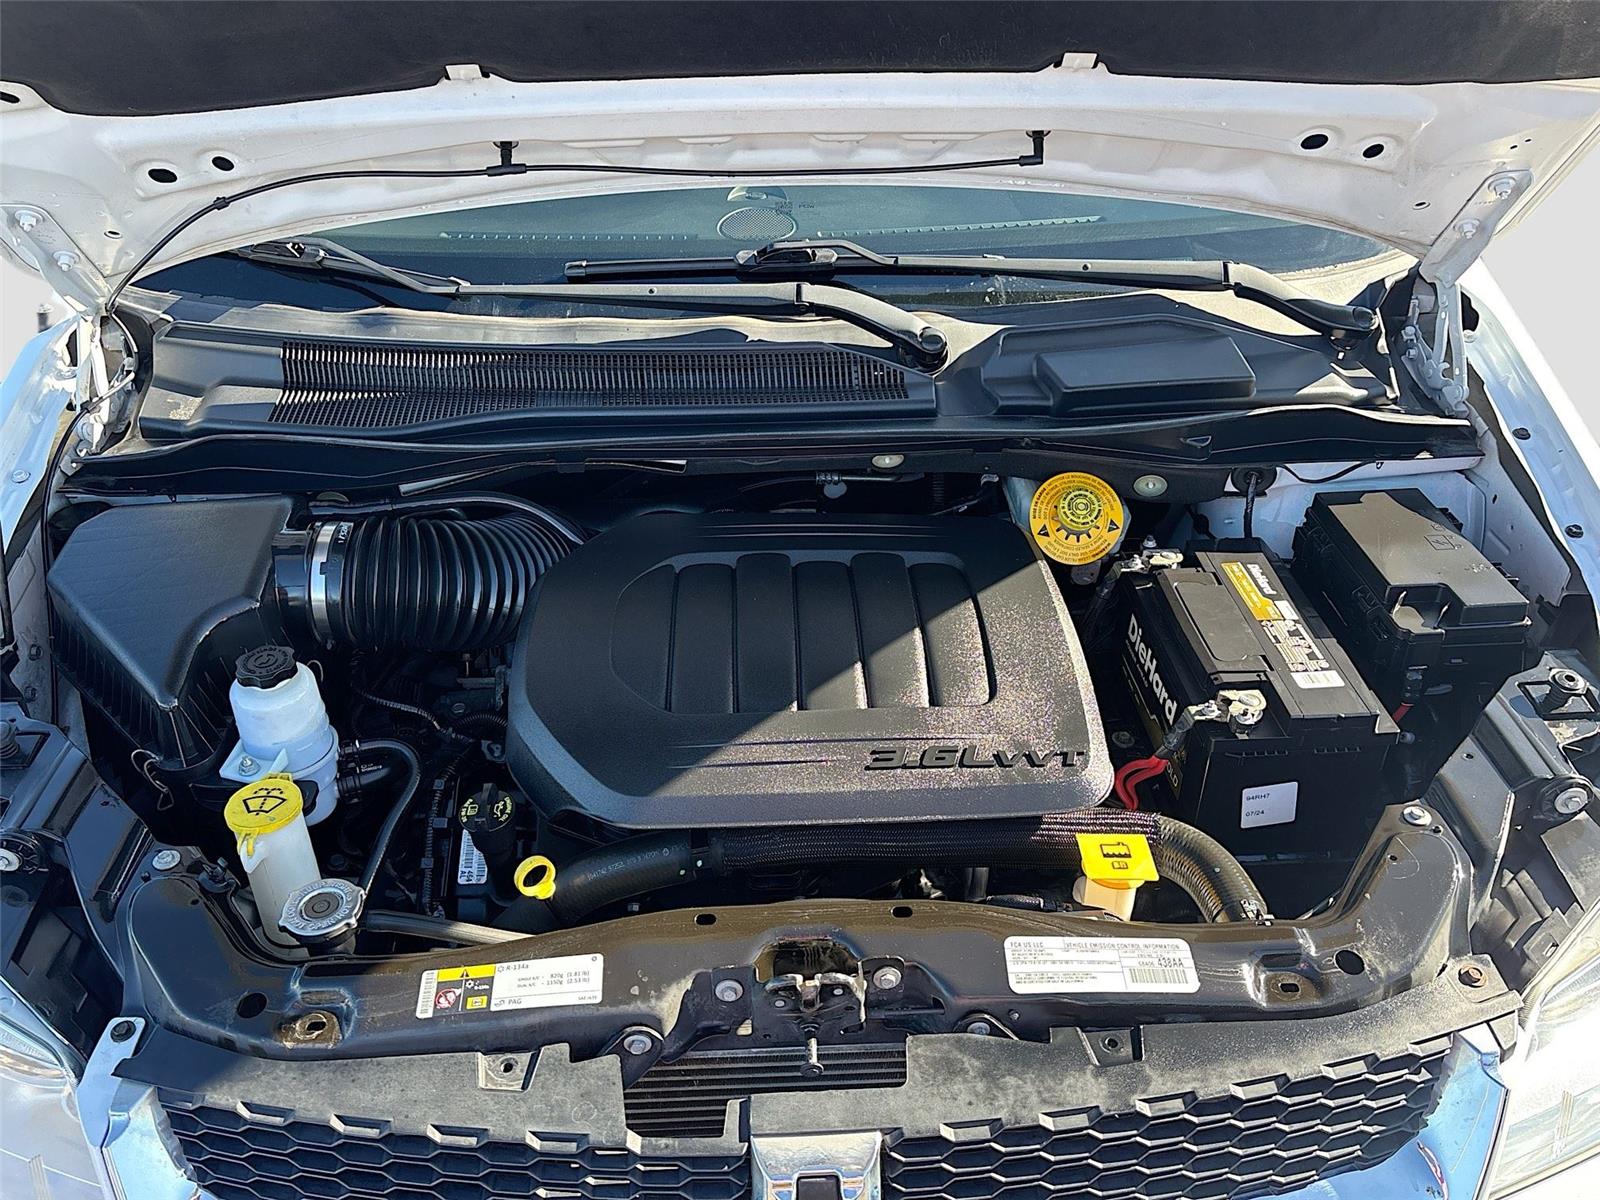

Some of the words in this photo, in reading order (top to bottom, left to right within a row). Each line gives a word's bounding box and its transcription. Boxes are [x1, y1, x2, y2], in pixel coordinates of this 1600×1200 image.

[1128, 613, 1177, 726] DieHard
[1157, 957, 1184, 968] 438AA
[546, 979, 564, 987] 1150g
